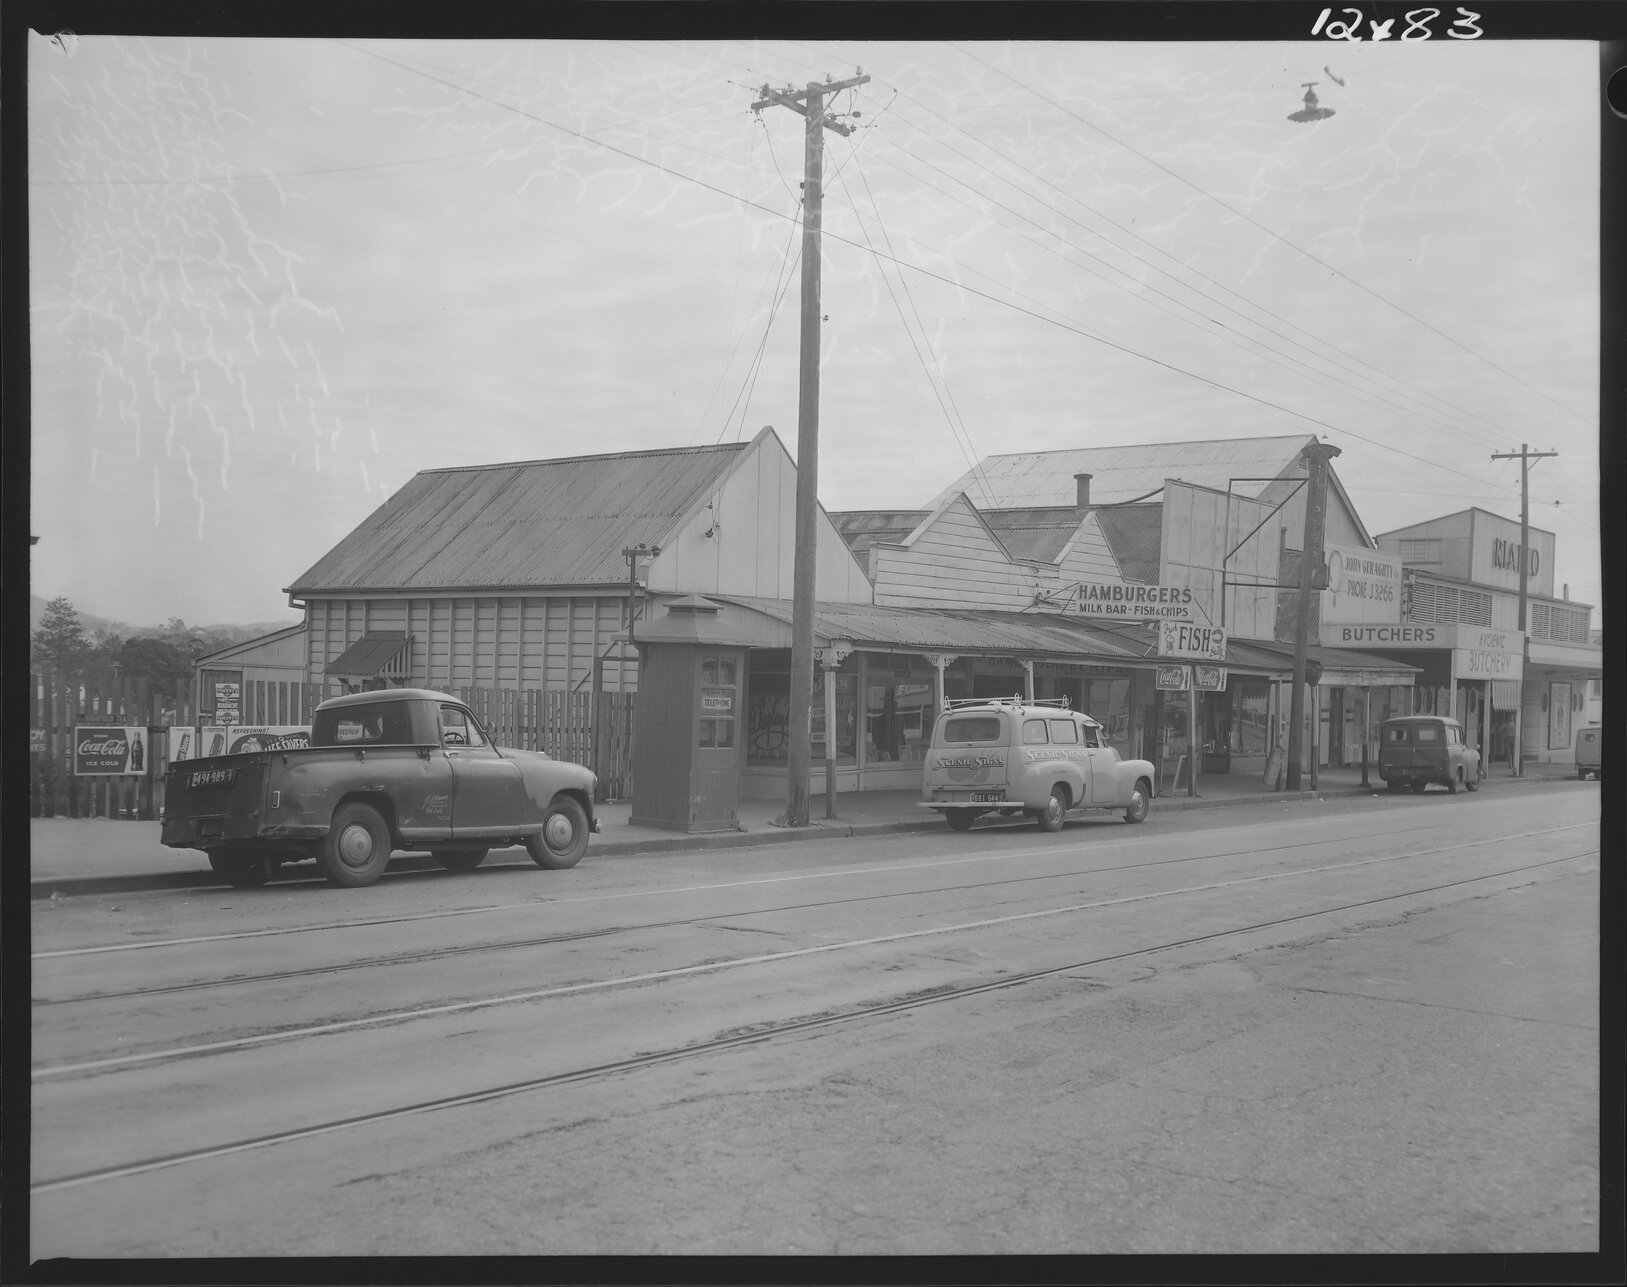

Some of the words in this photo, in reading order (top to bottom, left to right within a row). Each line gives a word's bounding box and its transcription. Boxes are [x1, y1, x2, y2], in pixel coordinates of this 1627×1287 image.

[1492, 538, 1539, 577] RIALO
[1345, 557, 1361, 572] JOHN
[1362, 560, 1393, 578] GERAGHTY
[1079, 585, 1192, 604] HAMBURGERS
[1347, 579, 1367, 599] PHONE
[1079, 603, 1102, 614] MILK
[1106, 604, 1127, 615] BAR
[1178, 626, 1212, 652] FISH
[1342, 628, 1435, 642] BUTCHERS
[1479, 633, 1506, 649] HYGIENIC
[1469, 651, 1511, 673] BUTCHERY
[704, 698, 730, 707] TELEPHONE
[932, 757, 972, 770] SCENIC
[971, 757, 1005, 770] SIGNS
[1026, 750, 1061, 764] SCENIC
[1061, 750, 1088, 762] SIGNS
